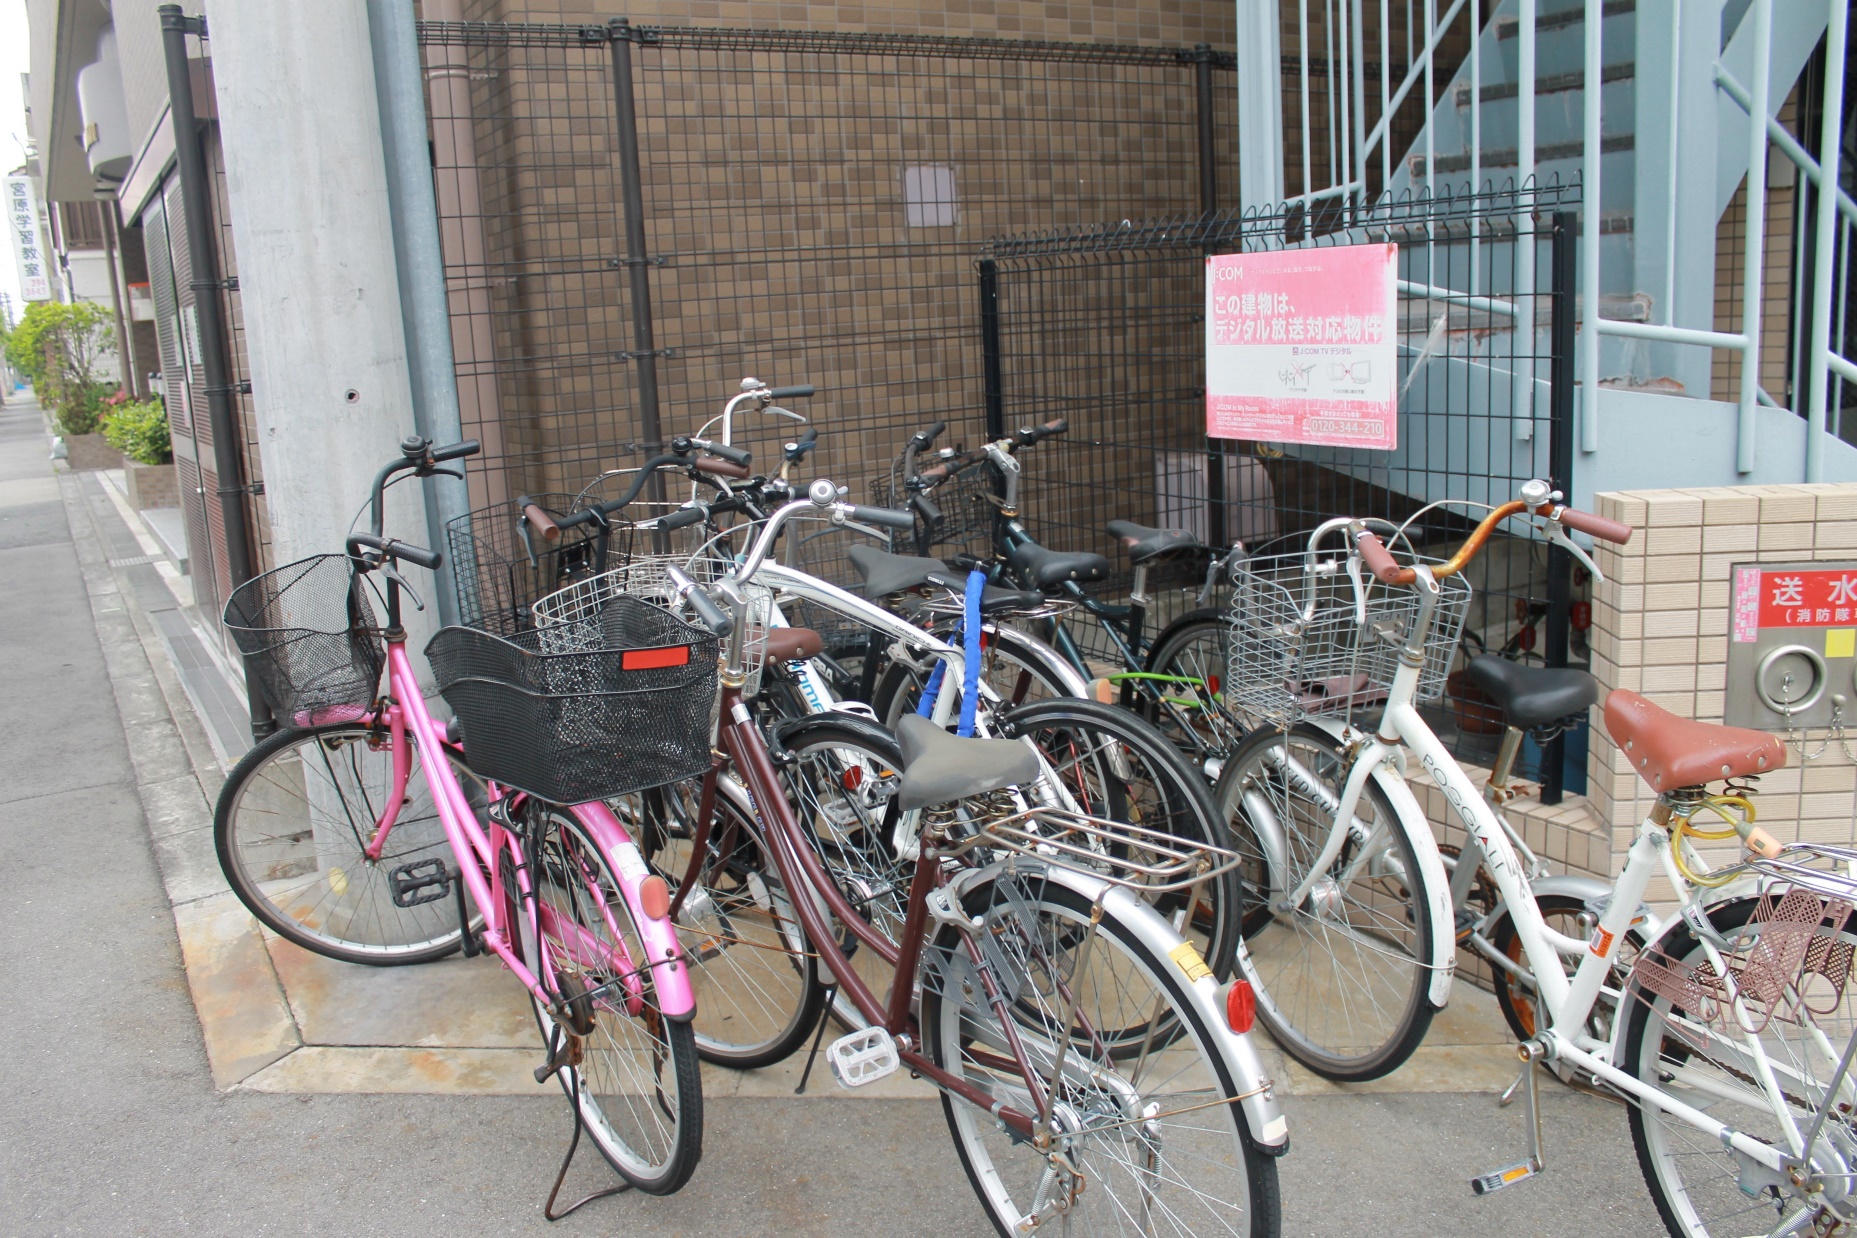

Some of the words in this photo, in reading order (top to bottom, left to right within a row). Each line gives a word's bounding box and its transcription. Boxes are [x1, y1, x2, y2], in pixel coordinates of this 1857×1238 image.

[1212, 266, 1243, 284] J:COM
[1215, 292, 1296, 315] この建物は、
[1215, 316, 1384, 341] デジタル放送対応物件
[1321, 347, 1329, 355] TV
[1330, 347, 1352, 355] デジタル
[1312, 420, 1382, 435] 0120-344-210
[1785, 607, 1857, 624] (消防隊
